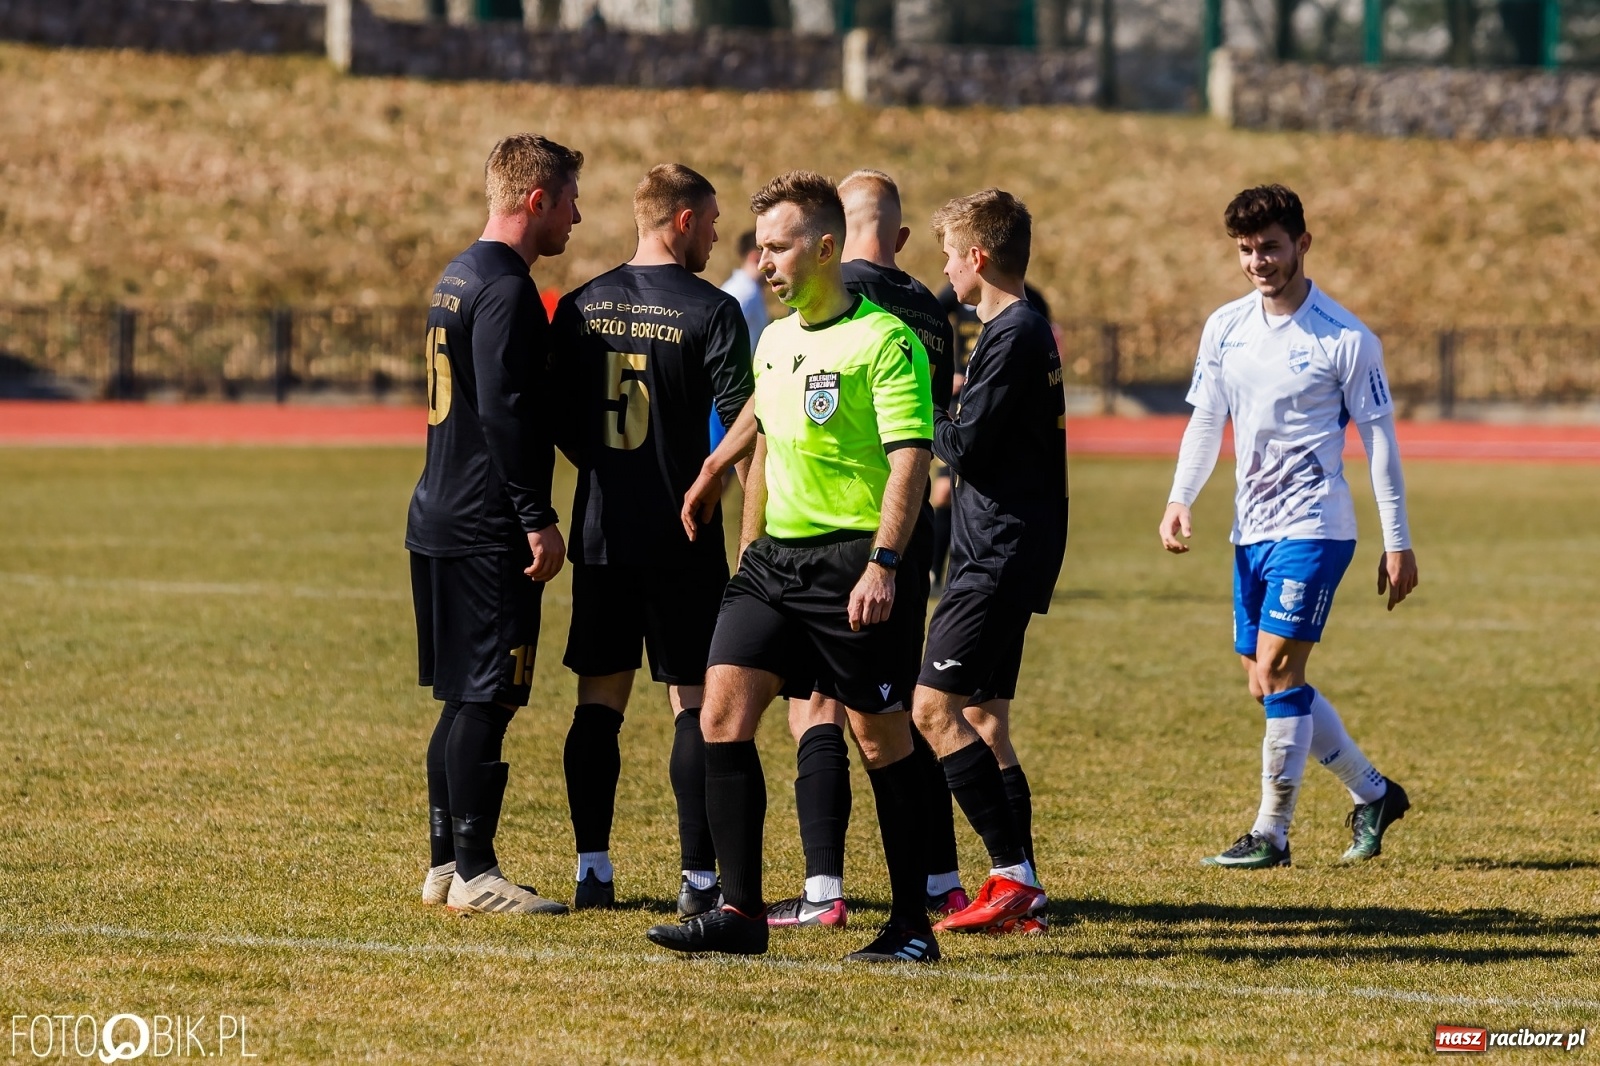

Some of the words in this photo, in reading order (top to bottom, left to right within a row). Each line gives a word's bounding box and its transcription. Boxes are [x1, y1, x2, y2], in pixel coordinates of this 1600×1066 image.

[583, 301, 613, 312] KLUB
[617, 303, 684, 318] SPORTOWY
[892, 305, 944, 329] SPORTOWY
[631, 322, 683, 344] BORUCIN
[604, 351, 650, 450] 5
